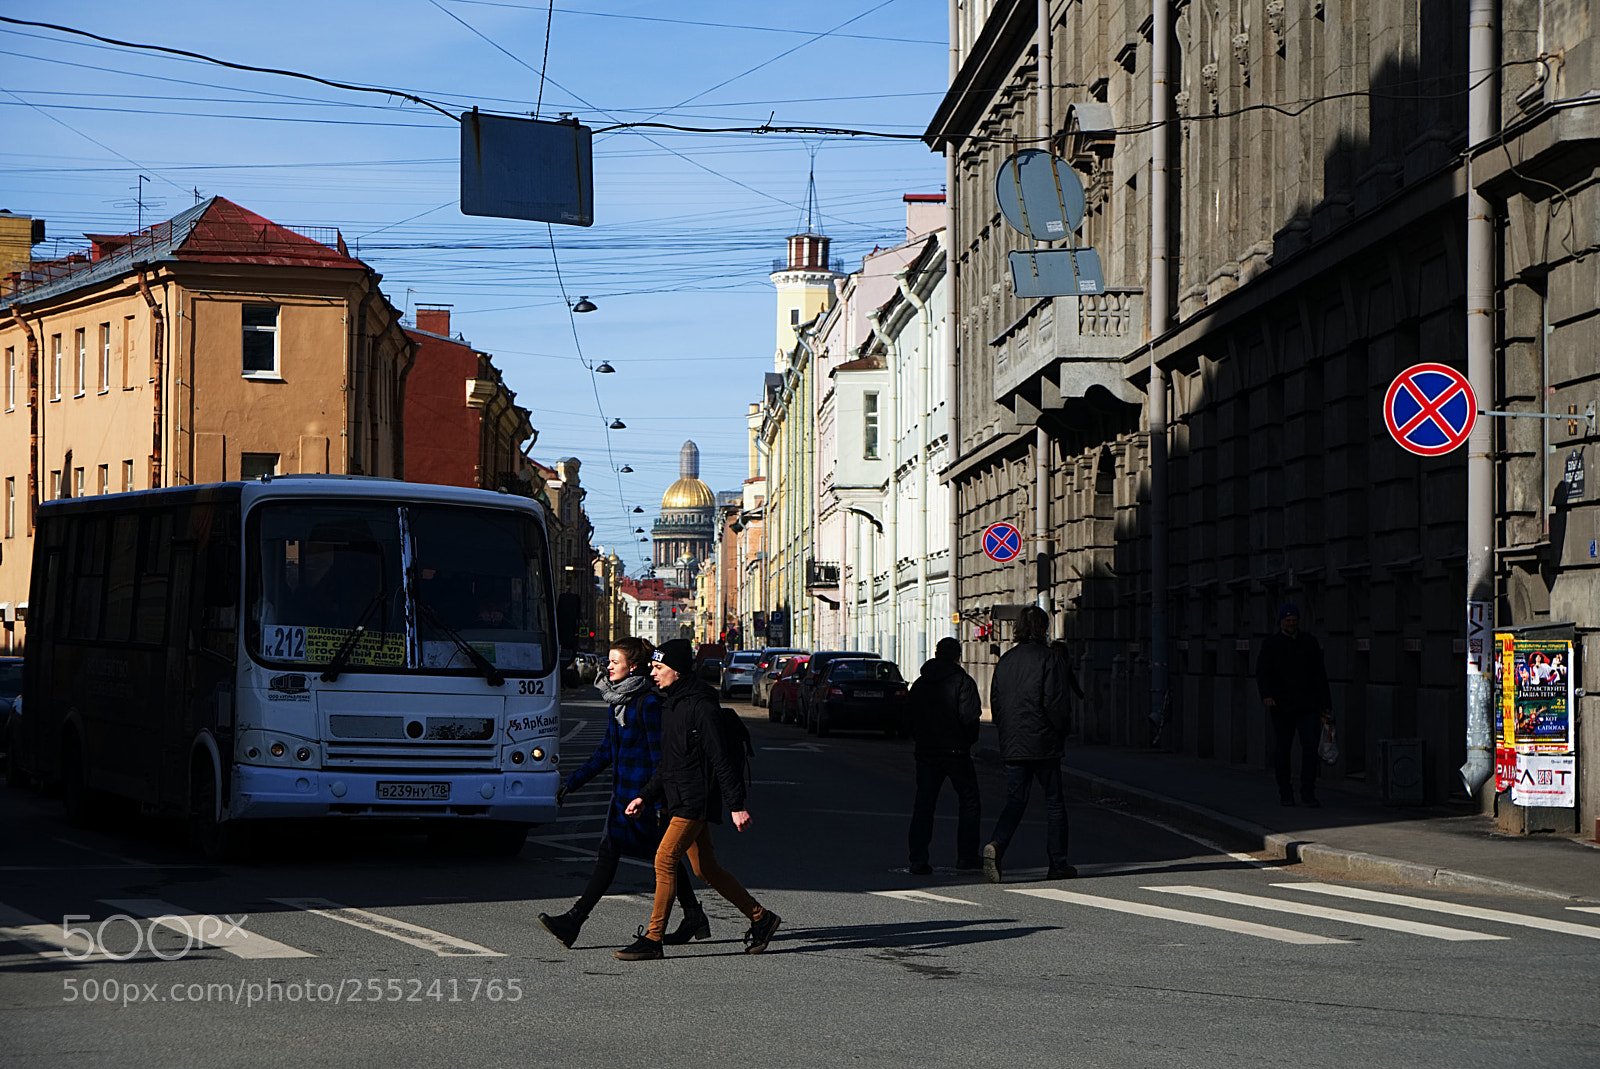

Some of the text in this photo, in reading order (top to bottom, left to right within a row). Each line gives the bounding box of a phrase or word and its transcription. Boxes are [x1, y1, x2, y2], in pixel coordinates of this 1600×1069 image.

[274, 627, 304, 657] 212
[333, 642, 382, 651] САОВАЯ
[374, 652, 402, 660] ДВОР
[519, 681, 544, 694] 302
[1556, 698, 1566, 706] 21
